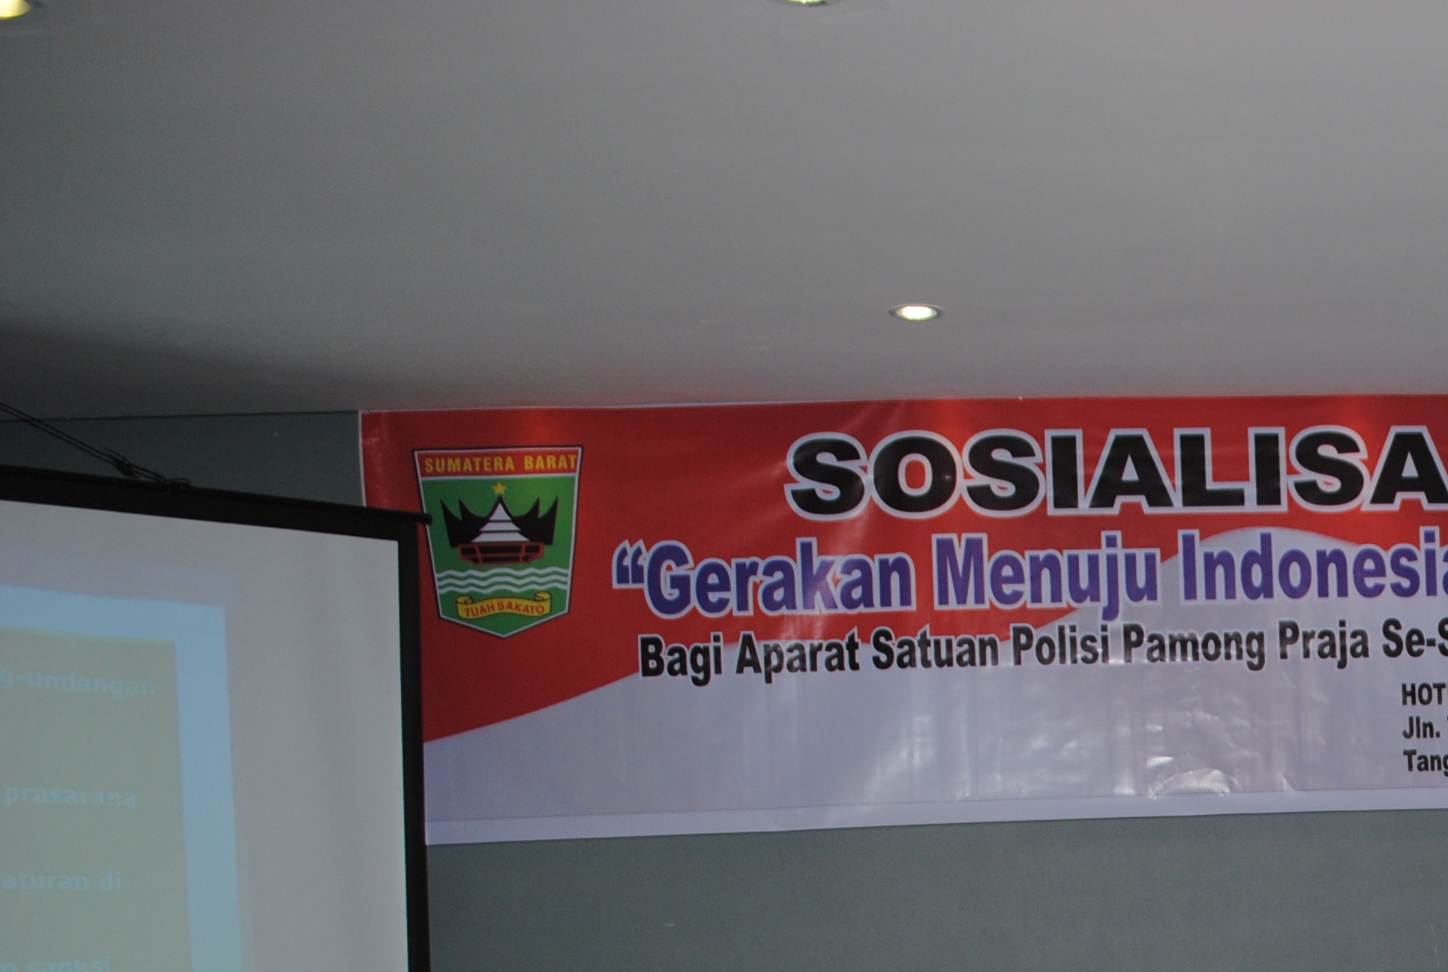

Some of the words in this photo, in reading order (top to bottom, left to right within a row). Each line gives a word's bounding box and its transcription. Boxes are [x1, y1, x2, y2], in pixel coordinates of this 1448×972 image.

[424, 456, 515, 473] SUMATERA
[523, 455, 577, 470] BARAT
[933, 530, 1160, 622] Menuju
[464, 604, 496, 618] TUAH
[497, 600, 546, 615] SAKATO
[639, 634, 723, 686] Bagi
[735, 629, 860, 684] Aparat
[871, 628, 999, 669] Satuan
[1011, 623, 1110, 666] Polisi
[1122, 623, 1266, 671] Pamong
[1278, 619, 1370, 669] Praja
[1402, 716, 1441, 739] Jln.
[5, 786, 137, 807] prasarana
[100, 871, 122, 890] di
